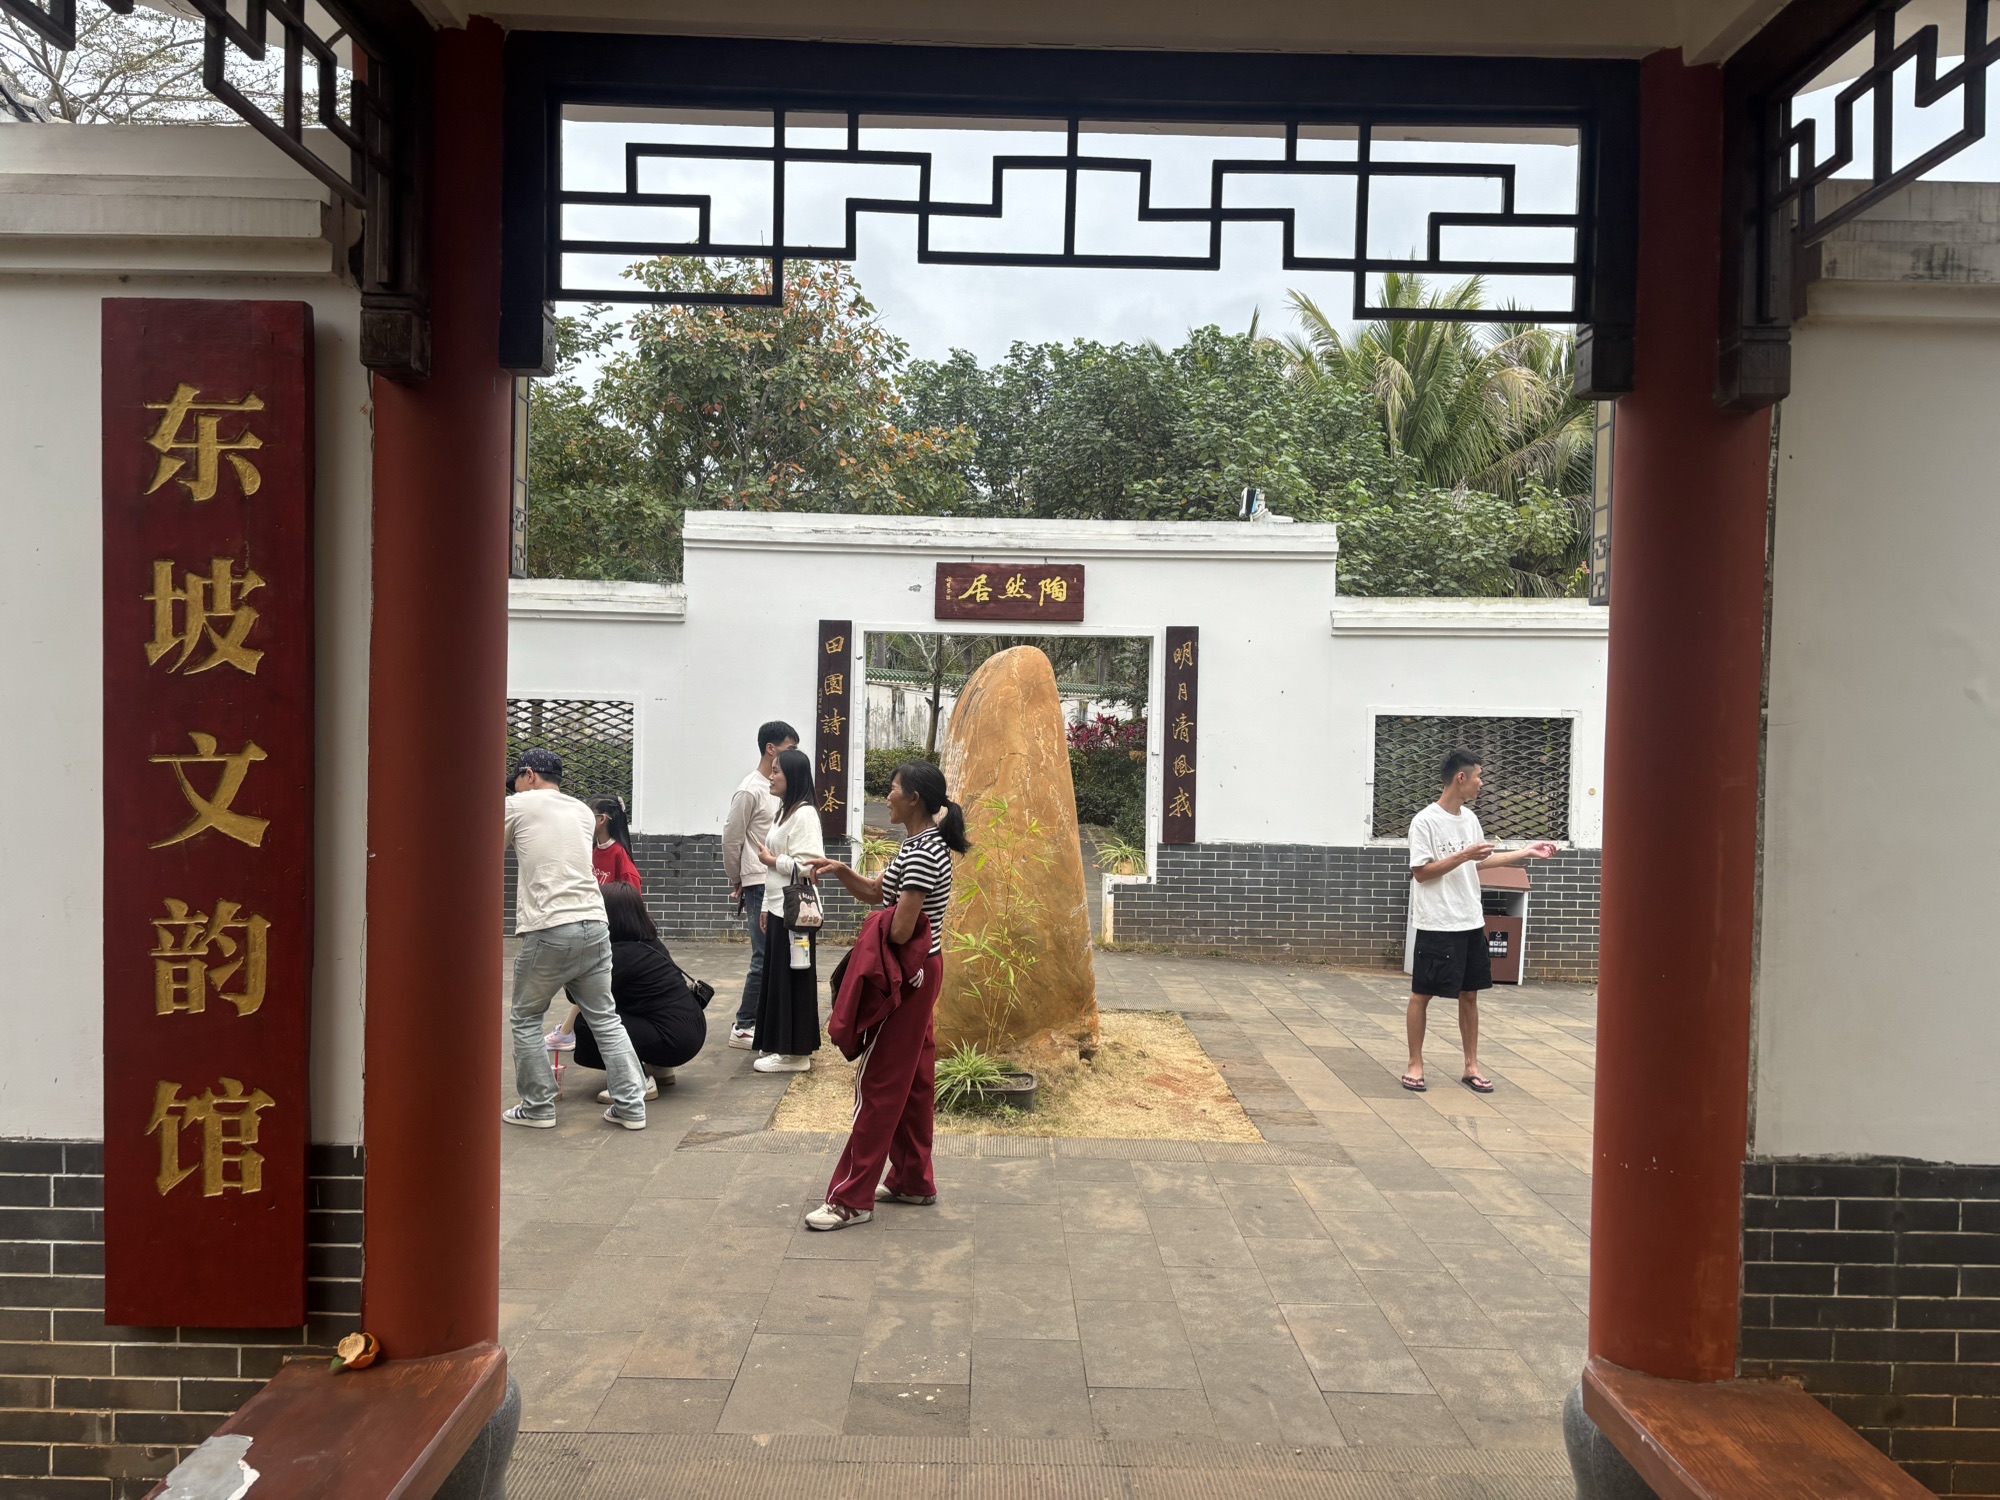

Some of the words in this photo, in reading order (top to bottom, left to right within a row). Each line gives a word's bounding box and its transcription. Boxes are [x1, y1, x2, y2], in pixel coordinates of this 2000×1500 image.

[144, 382, 276, 1199] 东坡文韵馆
[819, 635, 847, 813] 田園詩酒茶
[1168, 640, 1195, 818] 明月清風我
